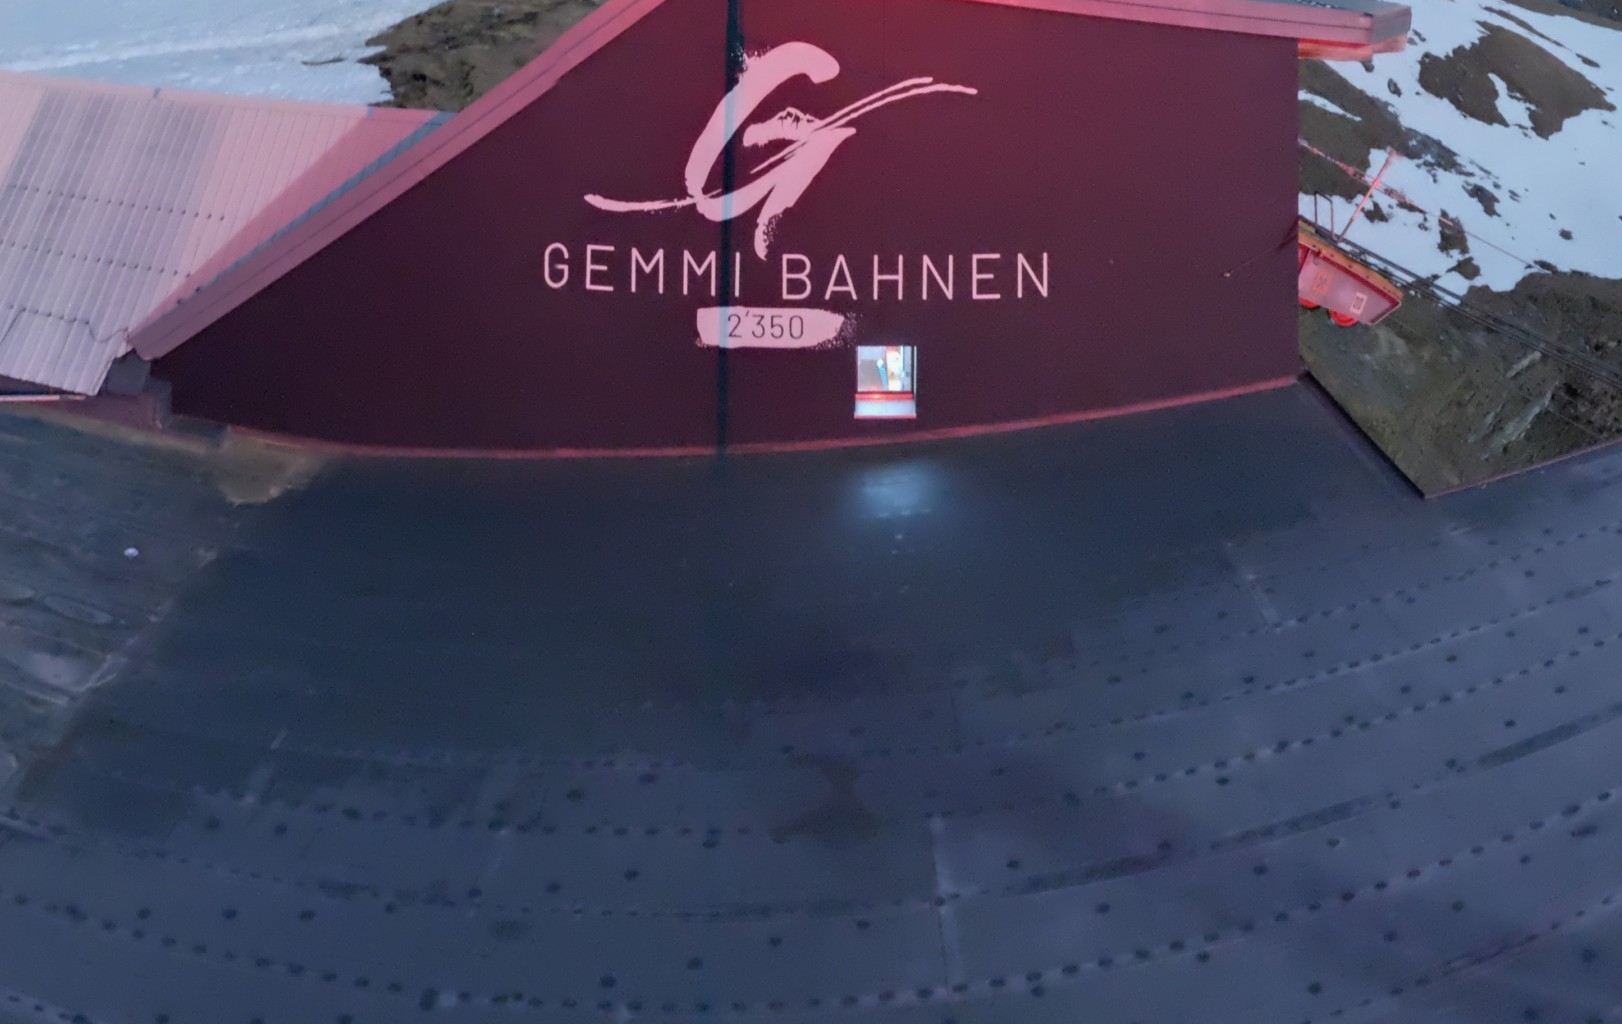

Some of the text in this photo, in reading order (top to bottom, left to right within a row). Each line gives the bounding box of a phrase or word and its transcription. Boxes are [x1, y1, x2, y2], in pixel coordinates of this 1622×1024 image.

[543, 242, 1049, 301] GEMMI BAHNEN
[727, 310, 805, 340] 2'350
